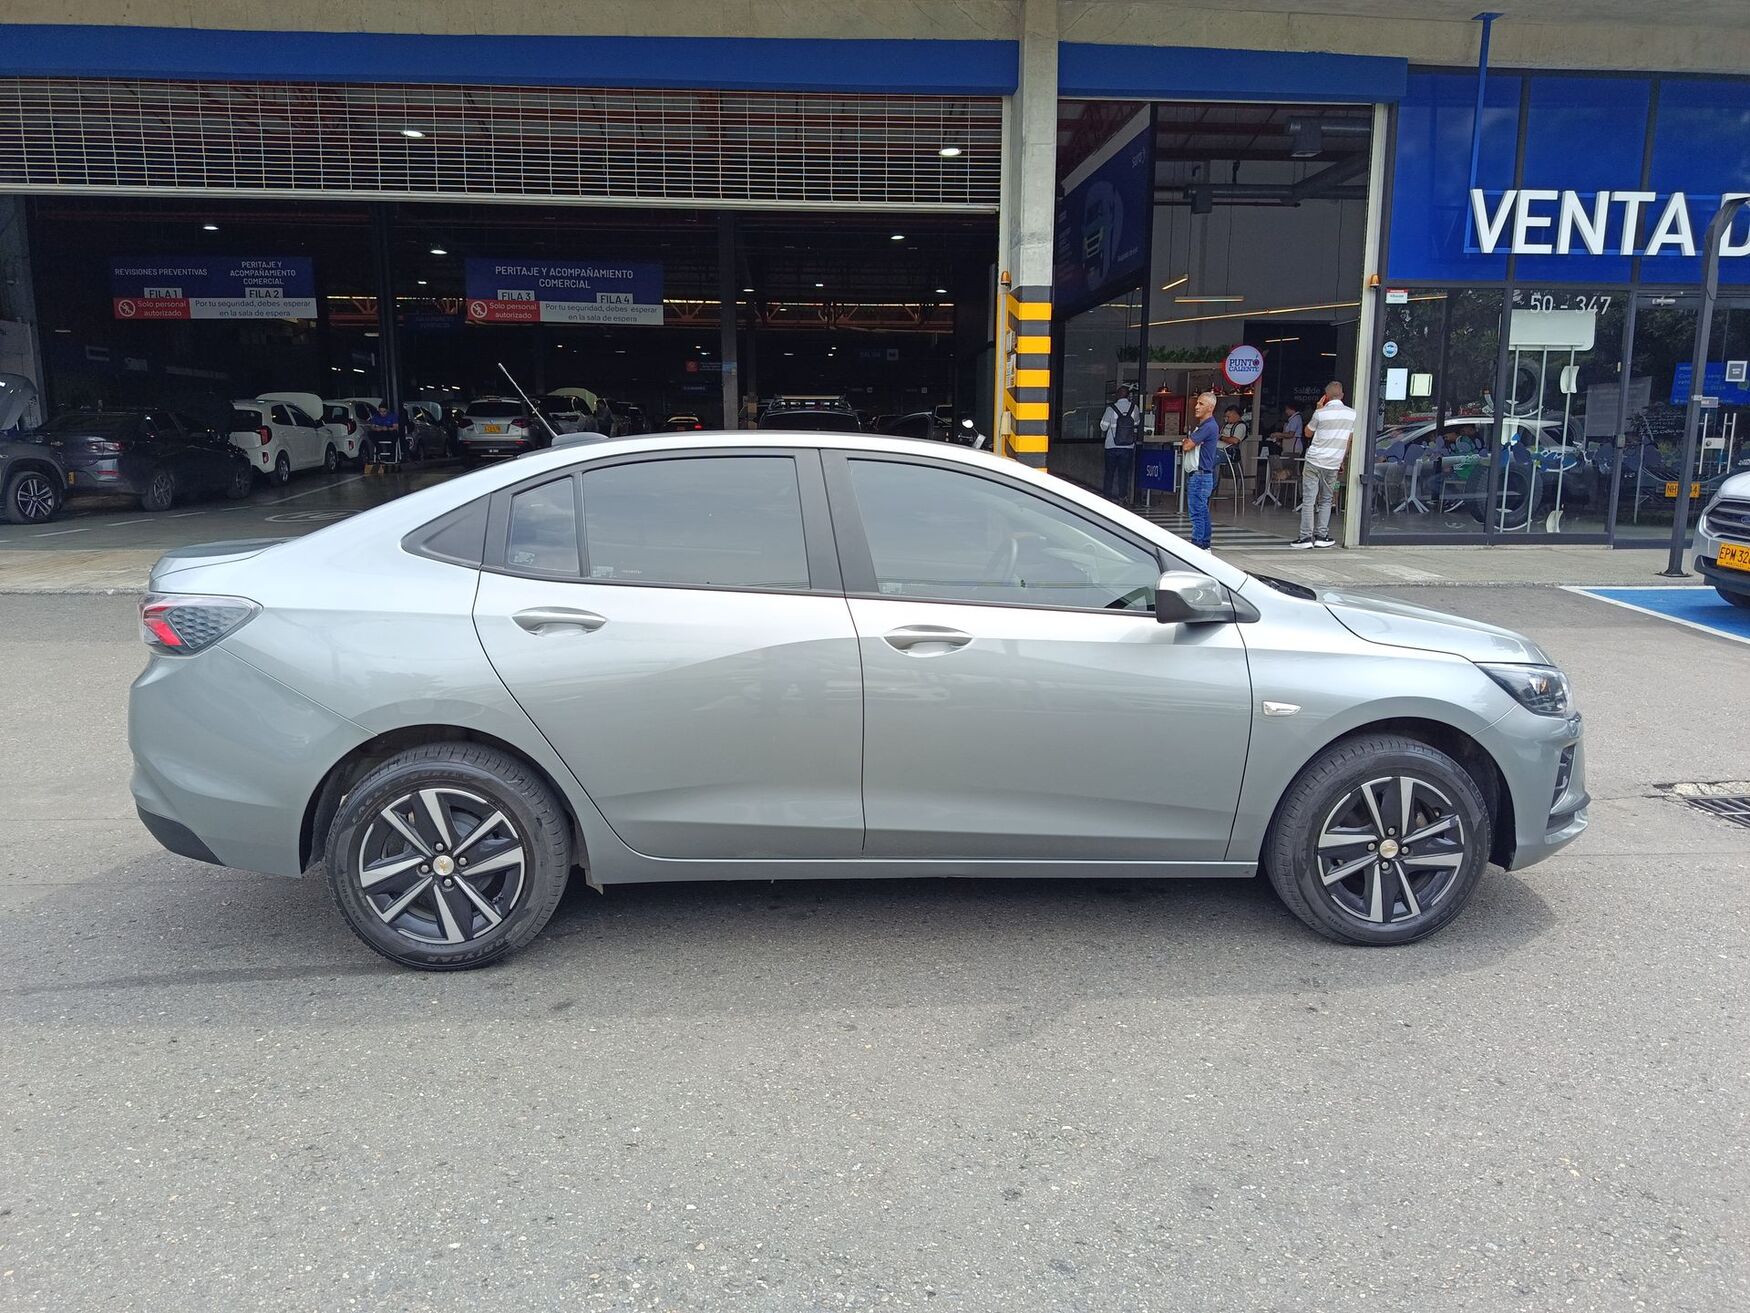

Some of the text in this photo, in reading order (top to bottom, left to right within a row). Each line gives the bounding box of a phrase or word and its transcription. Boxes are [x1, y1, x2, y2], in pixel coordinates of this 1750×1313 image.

[1470, 188, 1696, 257] VENTA
[114, 268, 208, 276] REVISIONES PREVENTIVAS
[230, 268, 296, 277] ACOMPAÑAMIENTO
[495, 266, 634, 279] PERITAJE Y ACOMPAÑAMIENTO
[539, 279, 591, 289] COMERCIAL
[149, 290, 171, 298] FILA
[249, 290, 279, 298] FILA 2
[501, 292, 531, 300] FILA 3
[600, 295, 630, 304] FILA 4
[138, 300, 186, 309] Solo personal
[257, 300, 280, 308] debes
[283, 301, 311, 309] esperar
[506, 303, 537, 312] personal
[545, 303, 557, 311] Por
[567, 304, 605, 314] seguridad,
[605, 305, 628, 313] debes
[630, 307, 657, 315] esperar
[1530, 295, 1554, 314] 50
[1575, 295, 1612, 315] 347
[613, 316, 638, 324] espera
[1229, 358, 1260, 367] PUNTO
[1719, 546, 1737, 561] EPM
[1737, 548, 1750, 565] 32
